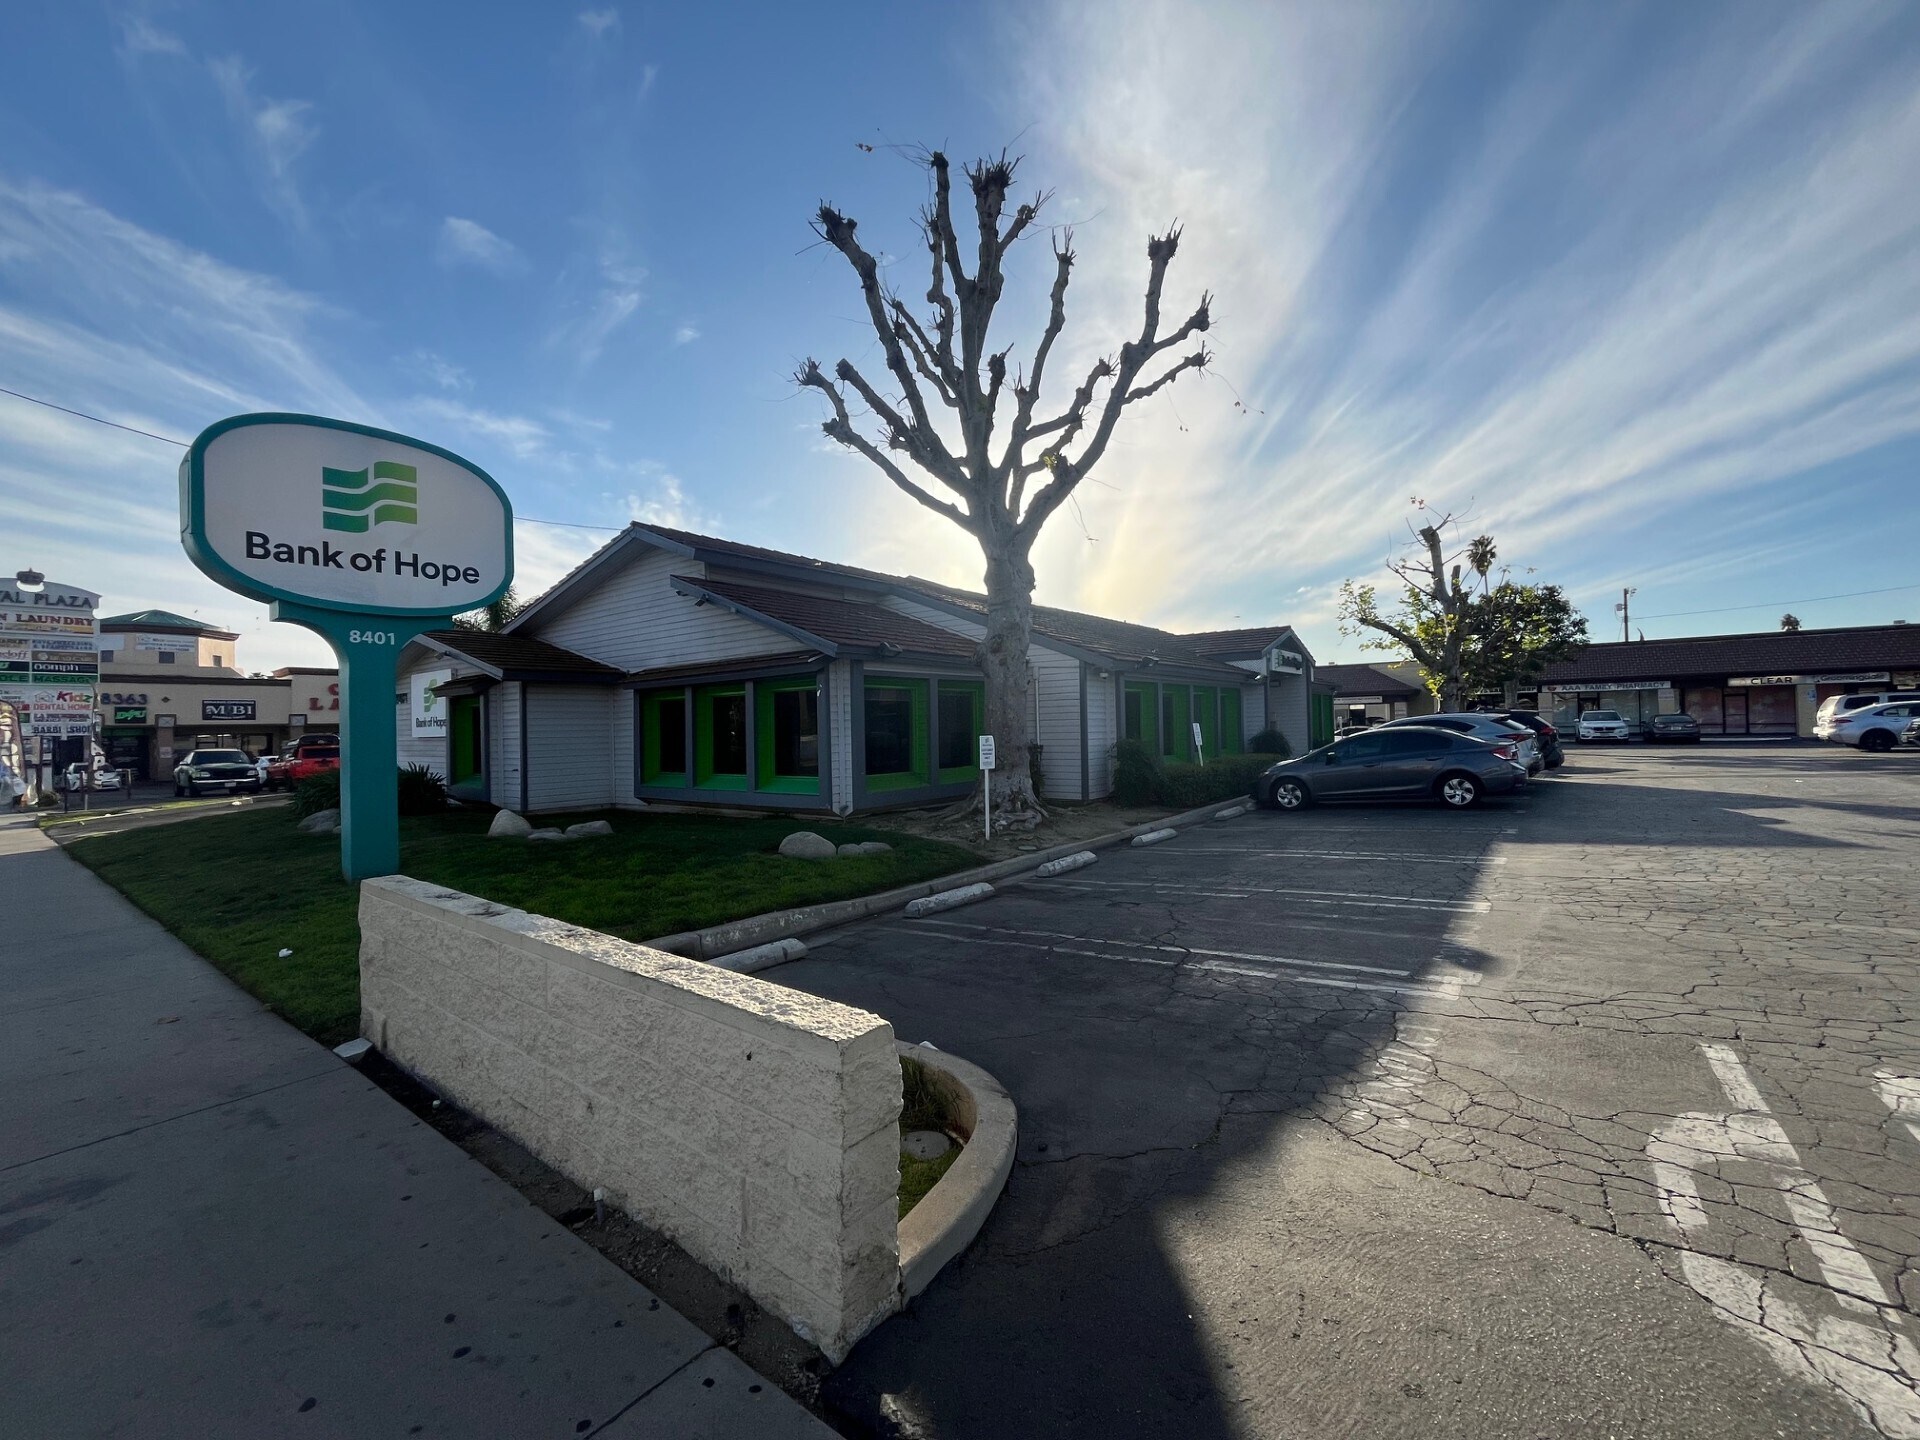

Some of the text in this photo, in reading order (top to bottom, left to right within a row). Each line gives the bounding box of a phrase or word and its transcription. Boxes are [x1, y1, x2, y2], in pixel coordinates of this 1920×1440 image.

[245, 531, 481, 587] Bank of Hope
[34, 593, 93, 609] PLAZA
[16, 613, 94, 627] LAUNDRY
[349, 630, 396, 646] 8401
[34, 663, 79, 672] oomph
[1617, 681, 1665, 690] PHARMACY
[1751, 676, 1793, 685] CLEAR
[56, 690, 93, 703] Kidz
[101, 692, 147, 705] 8363
[33, 703, 93, 711] DENTAL HOME
